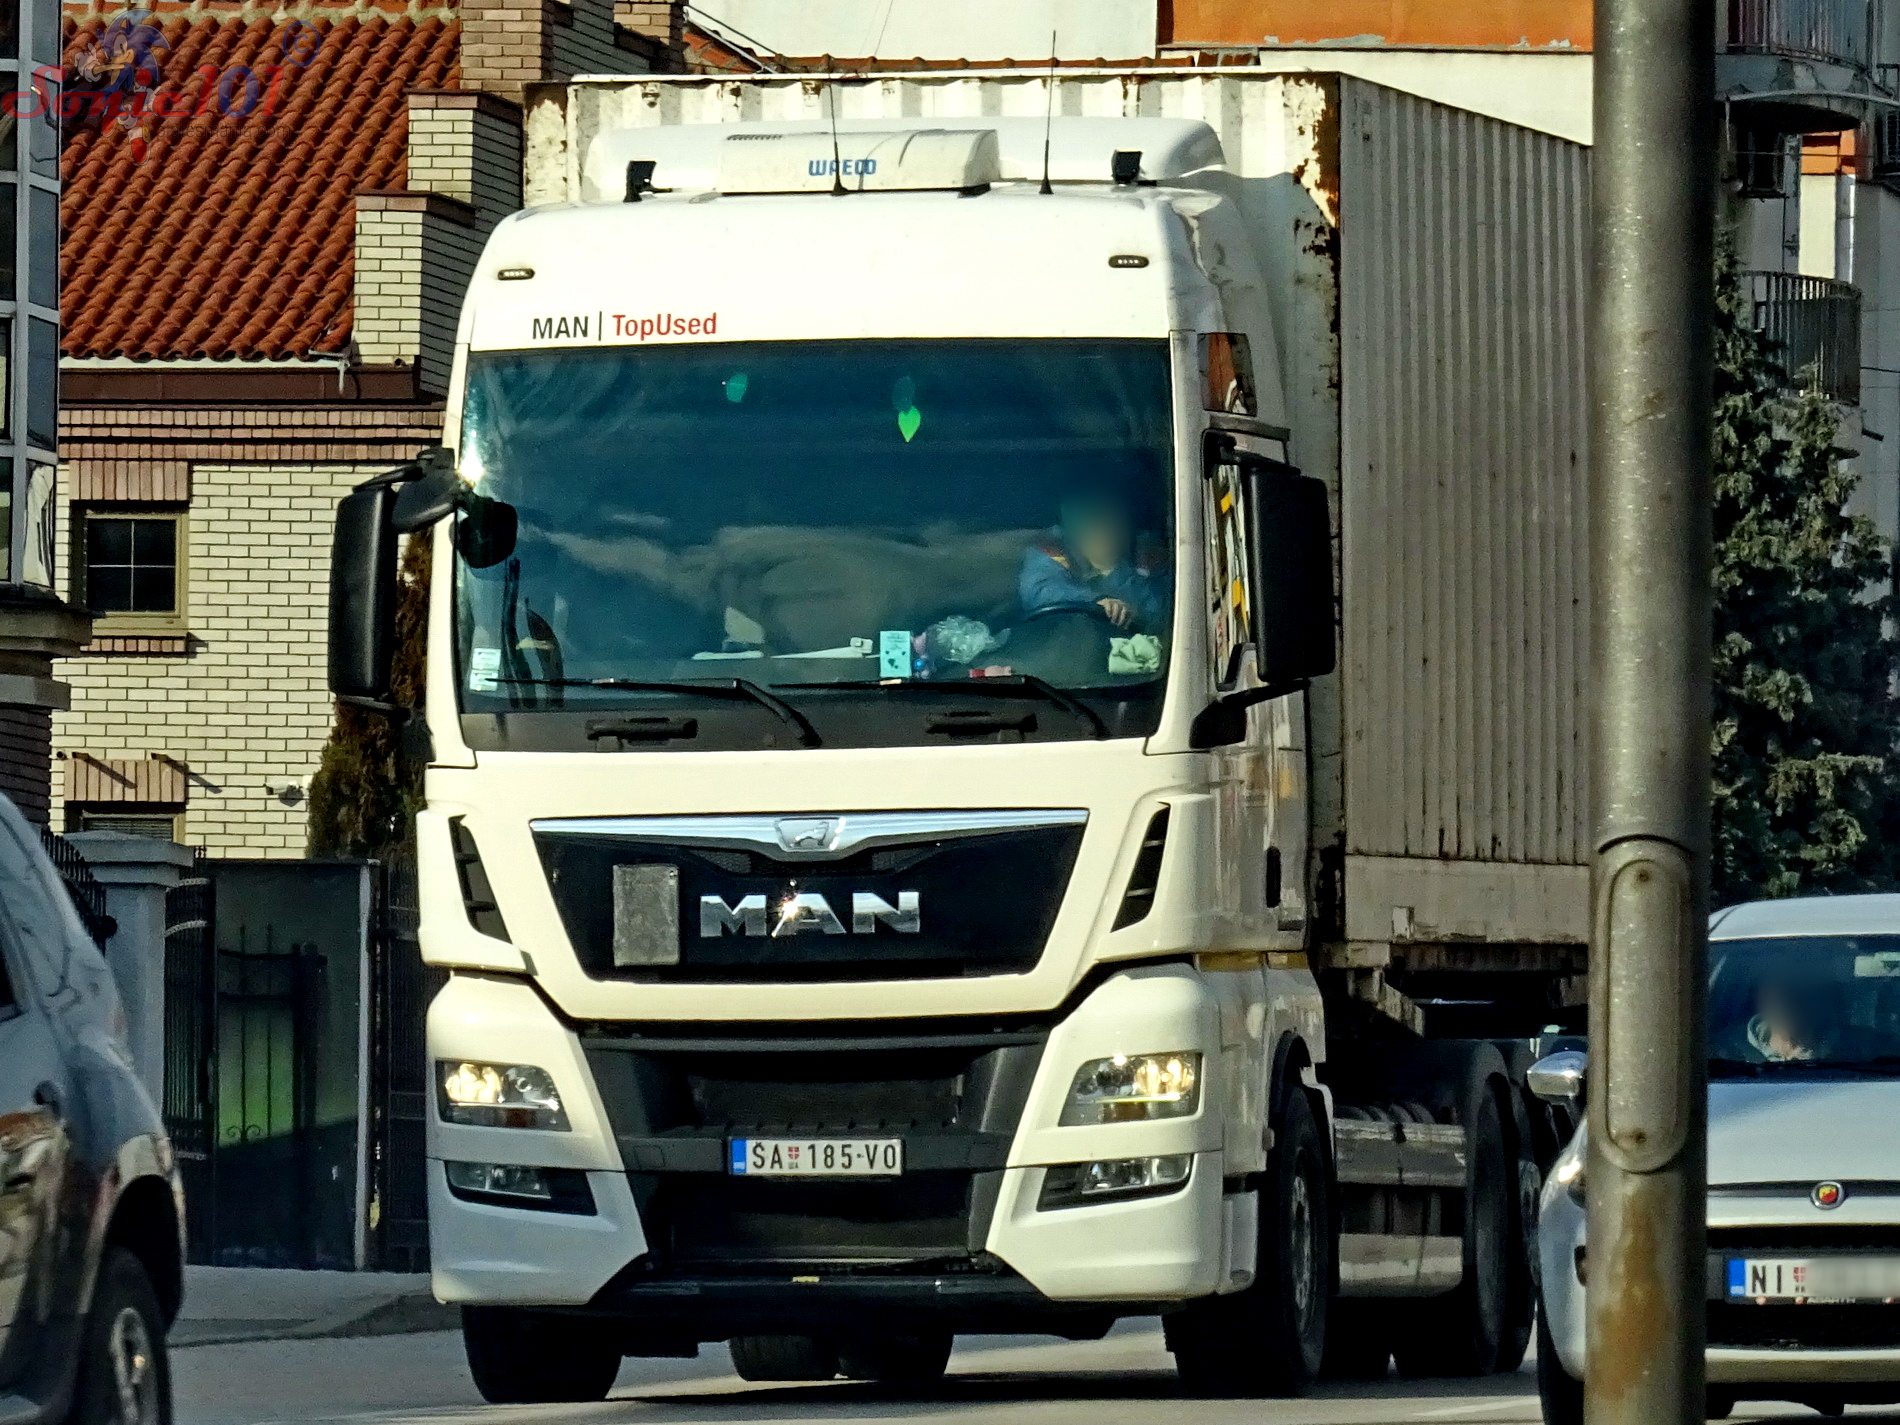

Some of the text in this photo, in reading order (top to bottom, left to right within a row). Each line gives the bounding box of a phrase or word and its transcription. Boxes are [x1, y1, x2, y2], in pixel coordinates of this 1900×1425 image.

[532, 312, 717, 341] MAN TopUsed
[700, 891, 920, 937] MAN
